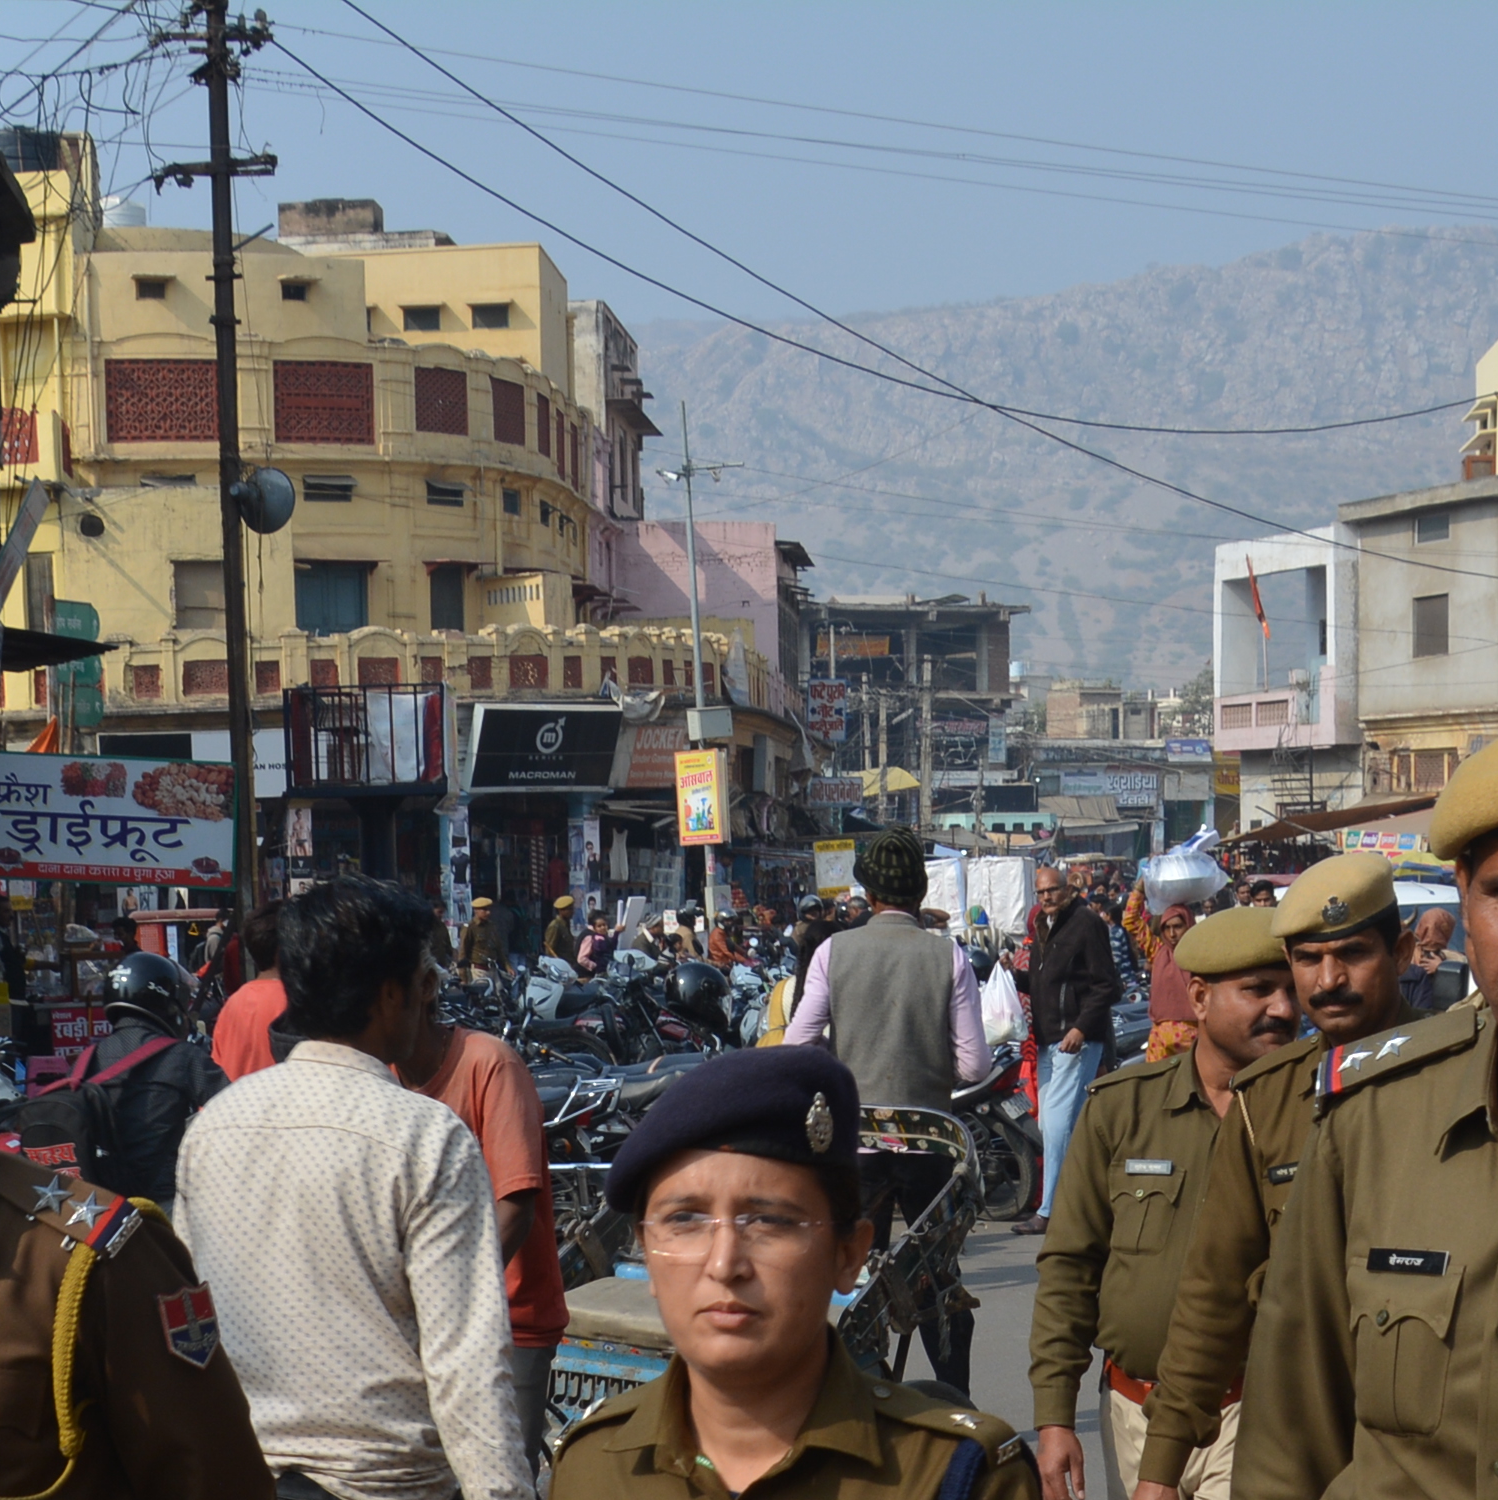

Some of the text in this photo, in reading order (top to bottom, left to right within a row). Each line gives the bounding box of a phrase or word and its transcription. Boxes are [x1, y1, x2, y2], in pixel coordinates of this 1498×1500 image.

[636, 728, 682, 749] JOCKEY
[508, 770, 576, 780] MACROMAN
[53, 1016, 89, 1042] रबड़ी
